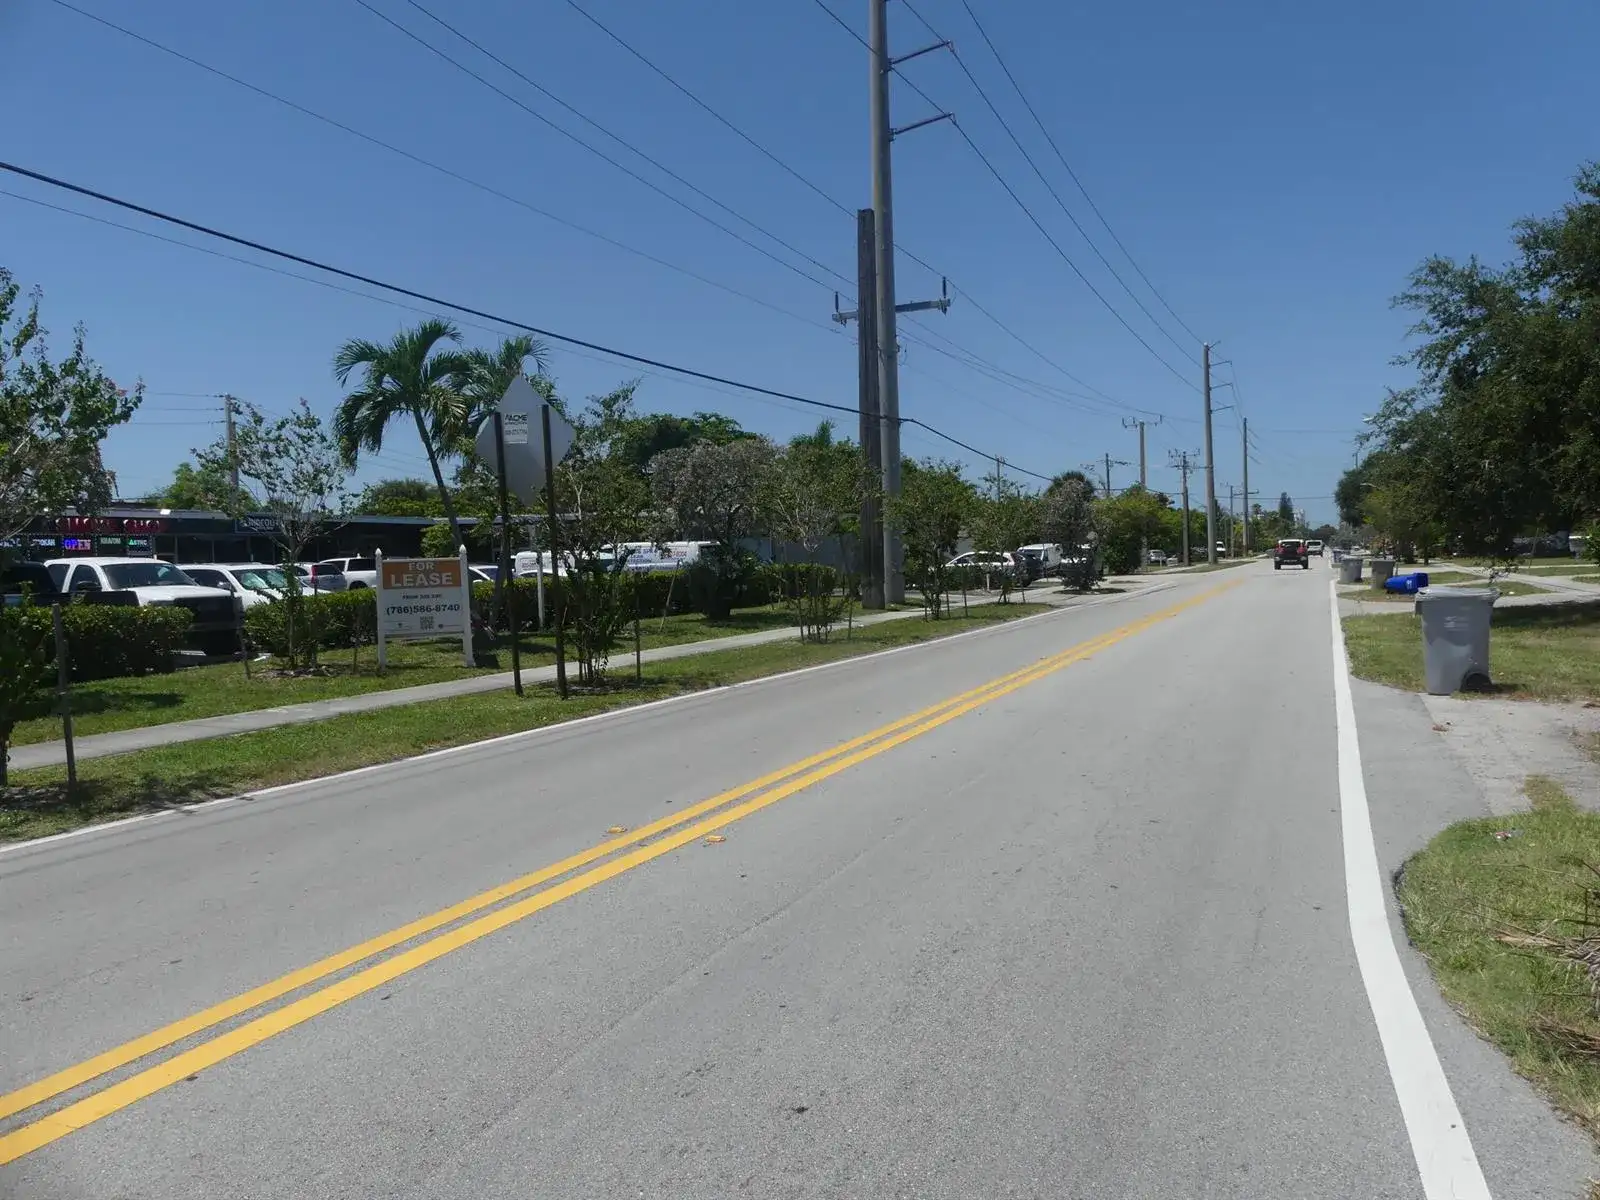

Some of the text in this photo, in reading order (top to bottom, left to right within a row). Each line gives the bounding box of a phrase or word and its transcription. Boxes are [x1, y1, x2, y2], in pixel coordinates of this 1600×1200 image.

[63, 538, 92, 550] OPEN
[408, 562, 435, 571] FOR
[390, 572, 453, 587] LEASE
